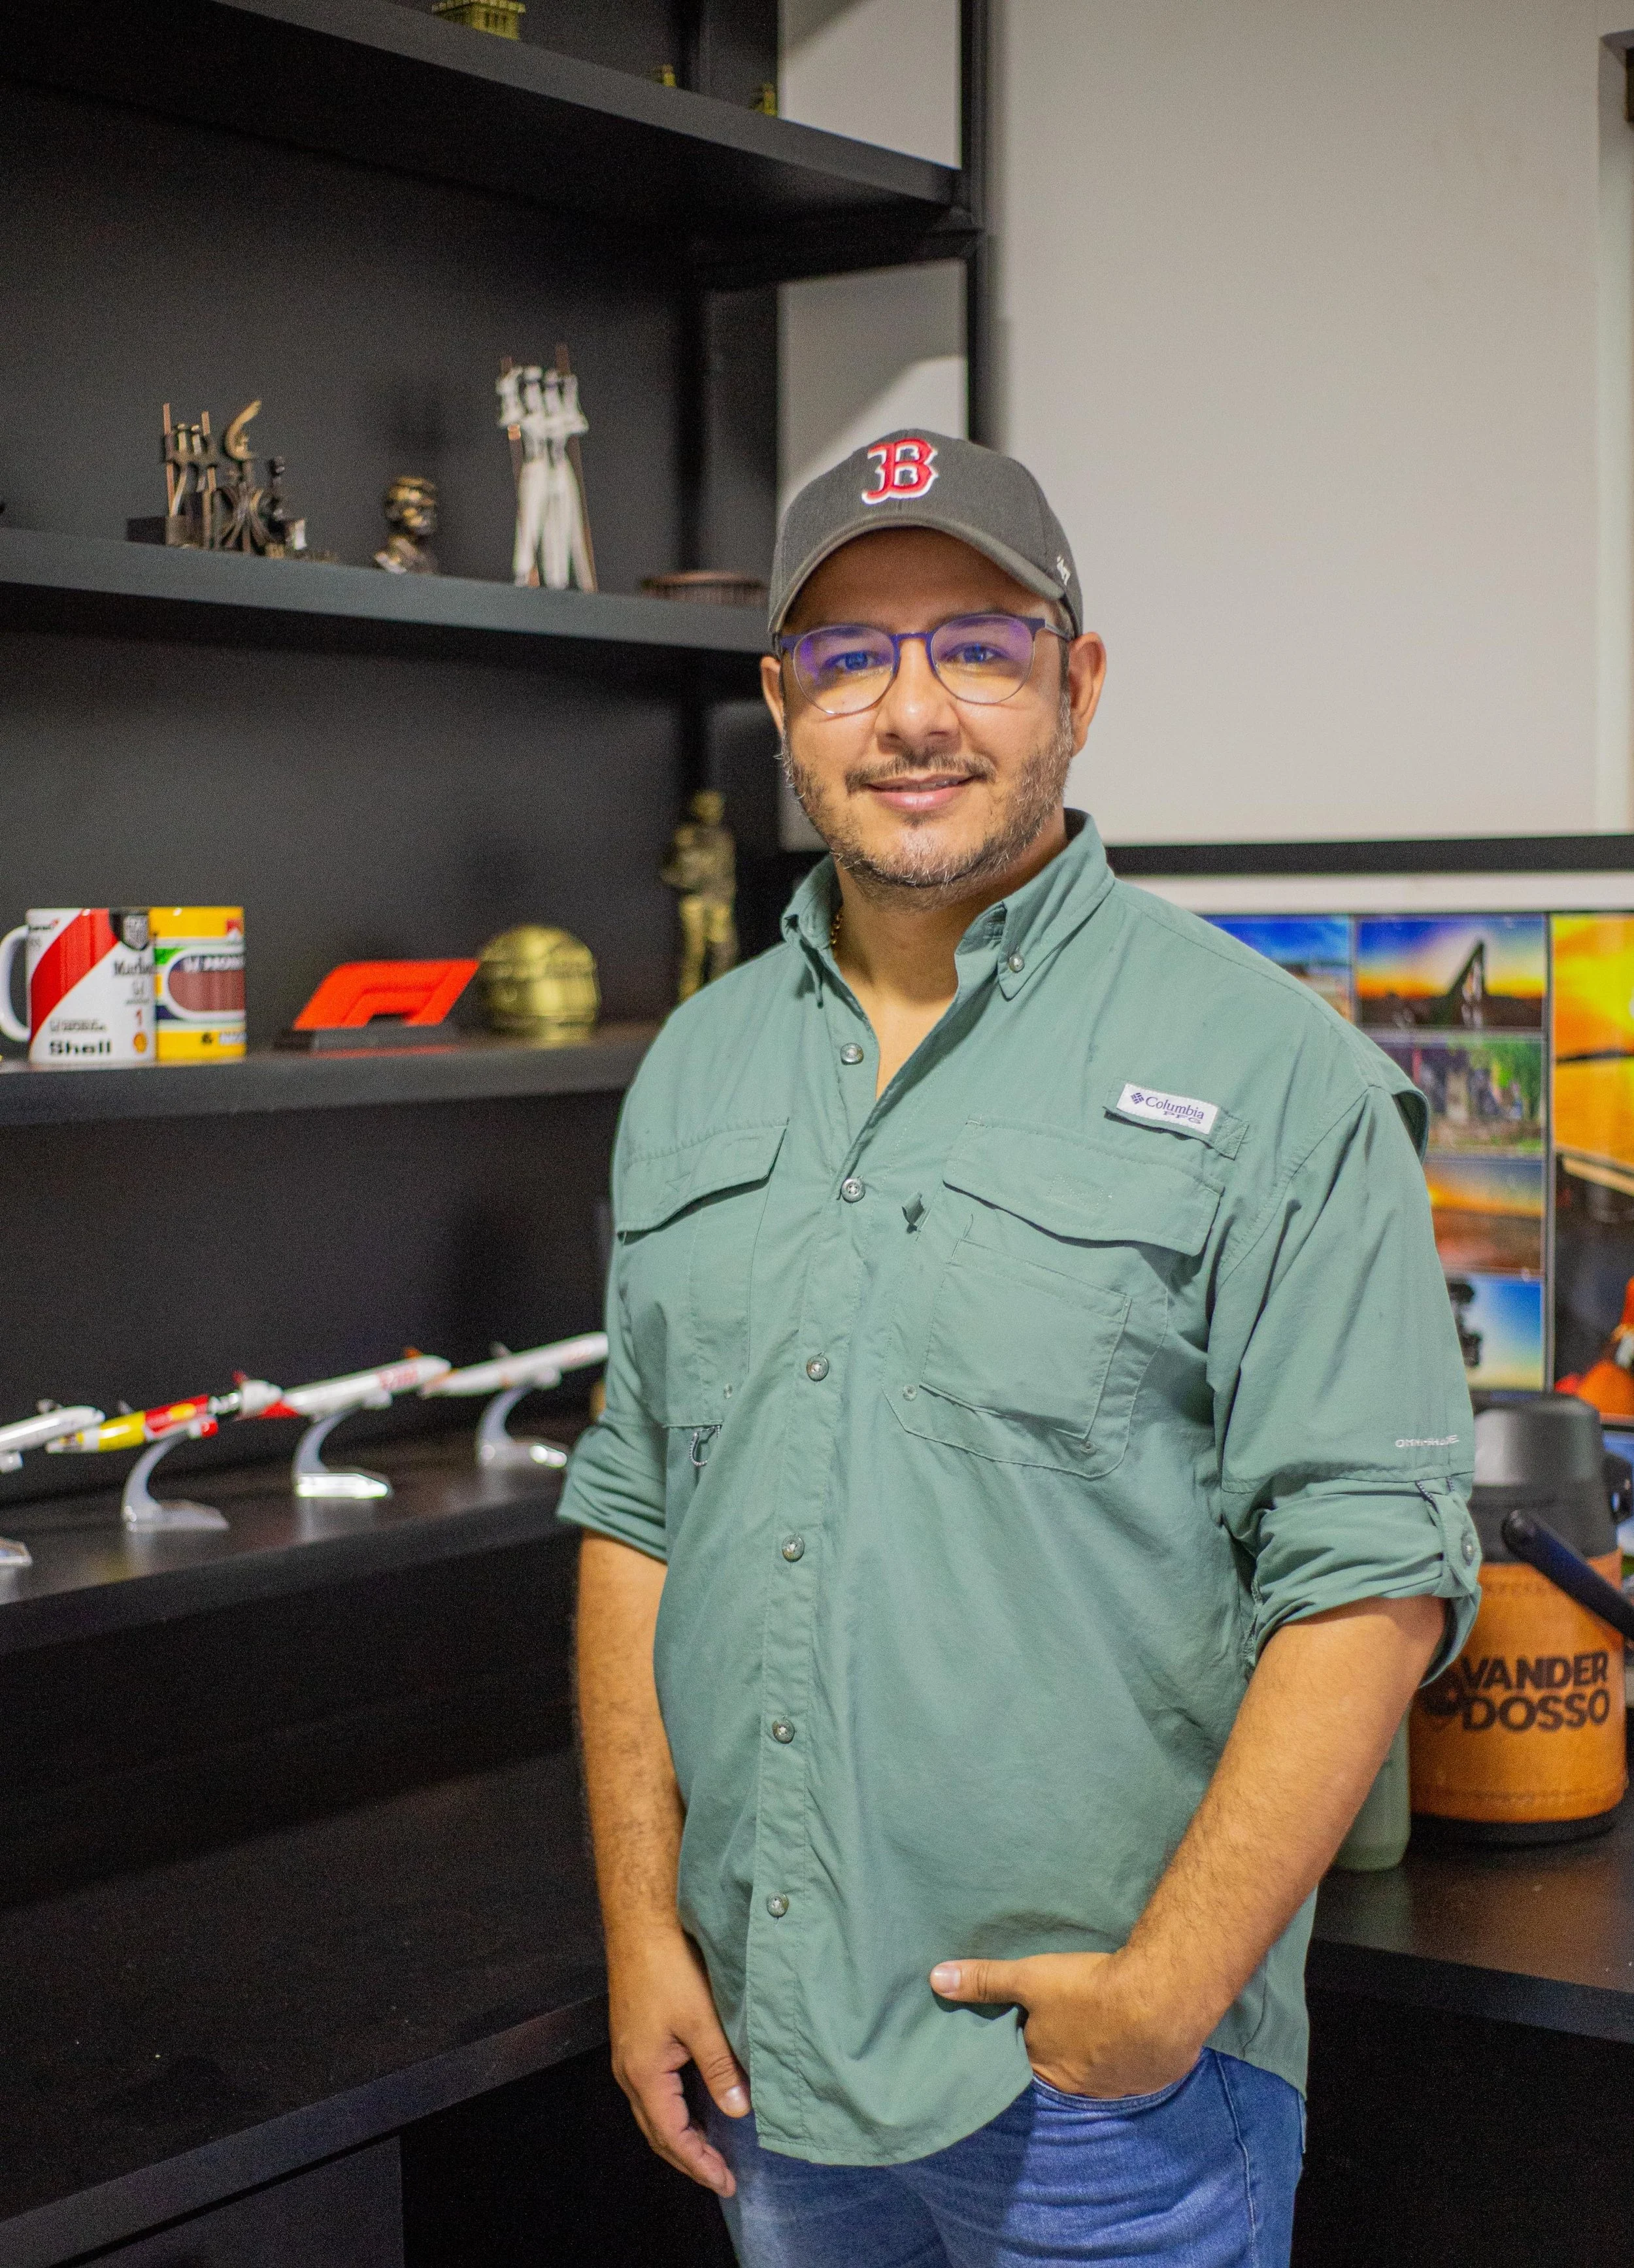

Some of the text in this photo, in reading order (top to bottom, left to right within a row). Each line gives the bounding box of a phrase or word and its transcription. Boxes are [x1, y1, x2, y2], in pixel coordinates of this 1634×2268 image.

[861, 437, 939, 505] B
[49, 1040, 112, 1055] Shell
[1146, 1097, 1204, 1120] Columbia
[1163, 1110, 1201, 1124] PFG
[1463, 1688, 1610, 1732] DOSSO
